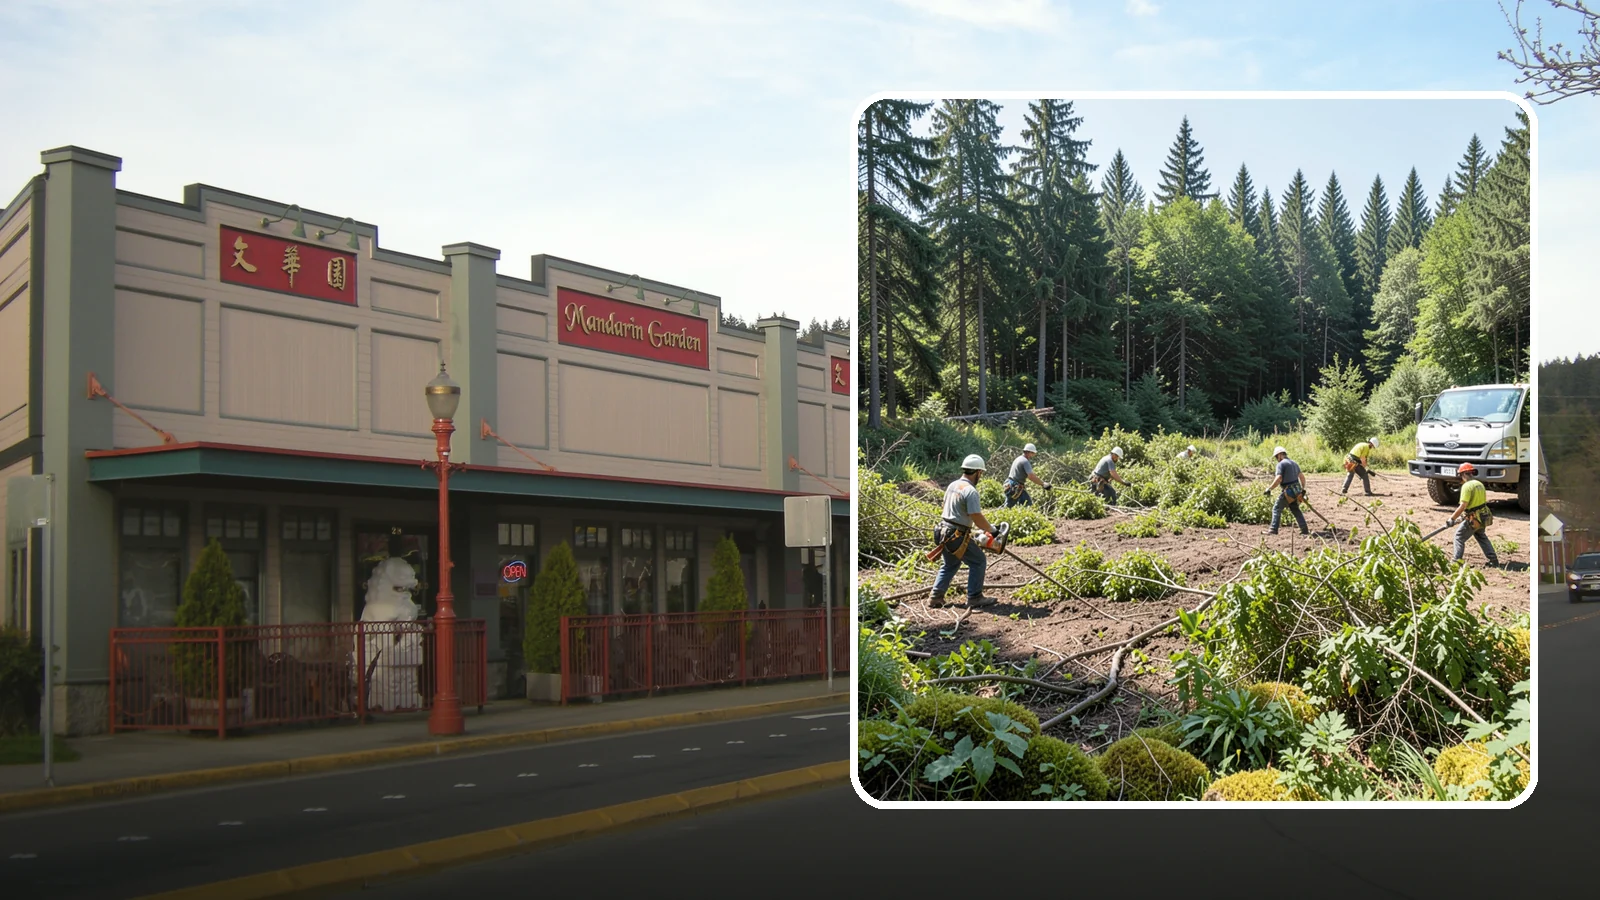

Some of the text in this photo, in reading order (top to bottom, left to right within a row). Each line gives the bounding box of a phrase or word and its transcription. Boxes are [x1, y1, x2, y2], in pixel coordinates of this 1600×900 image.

[231, 235, 347, 291] 文華園
[564, 302, 702, 352] Mandarin Garden
[503, 565, 527, 578] OPEN
